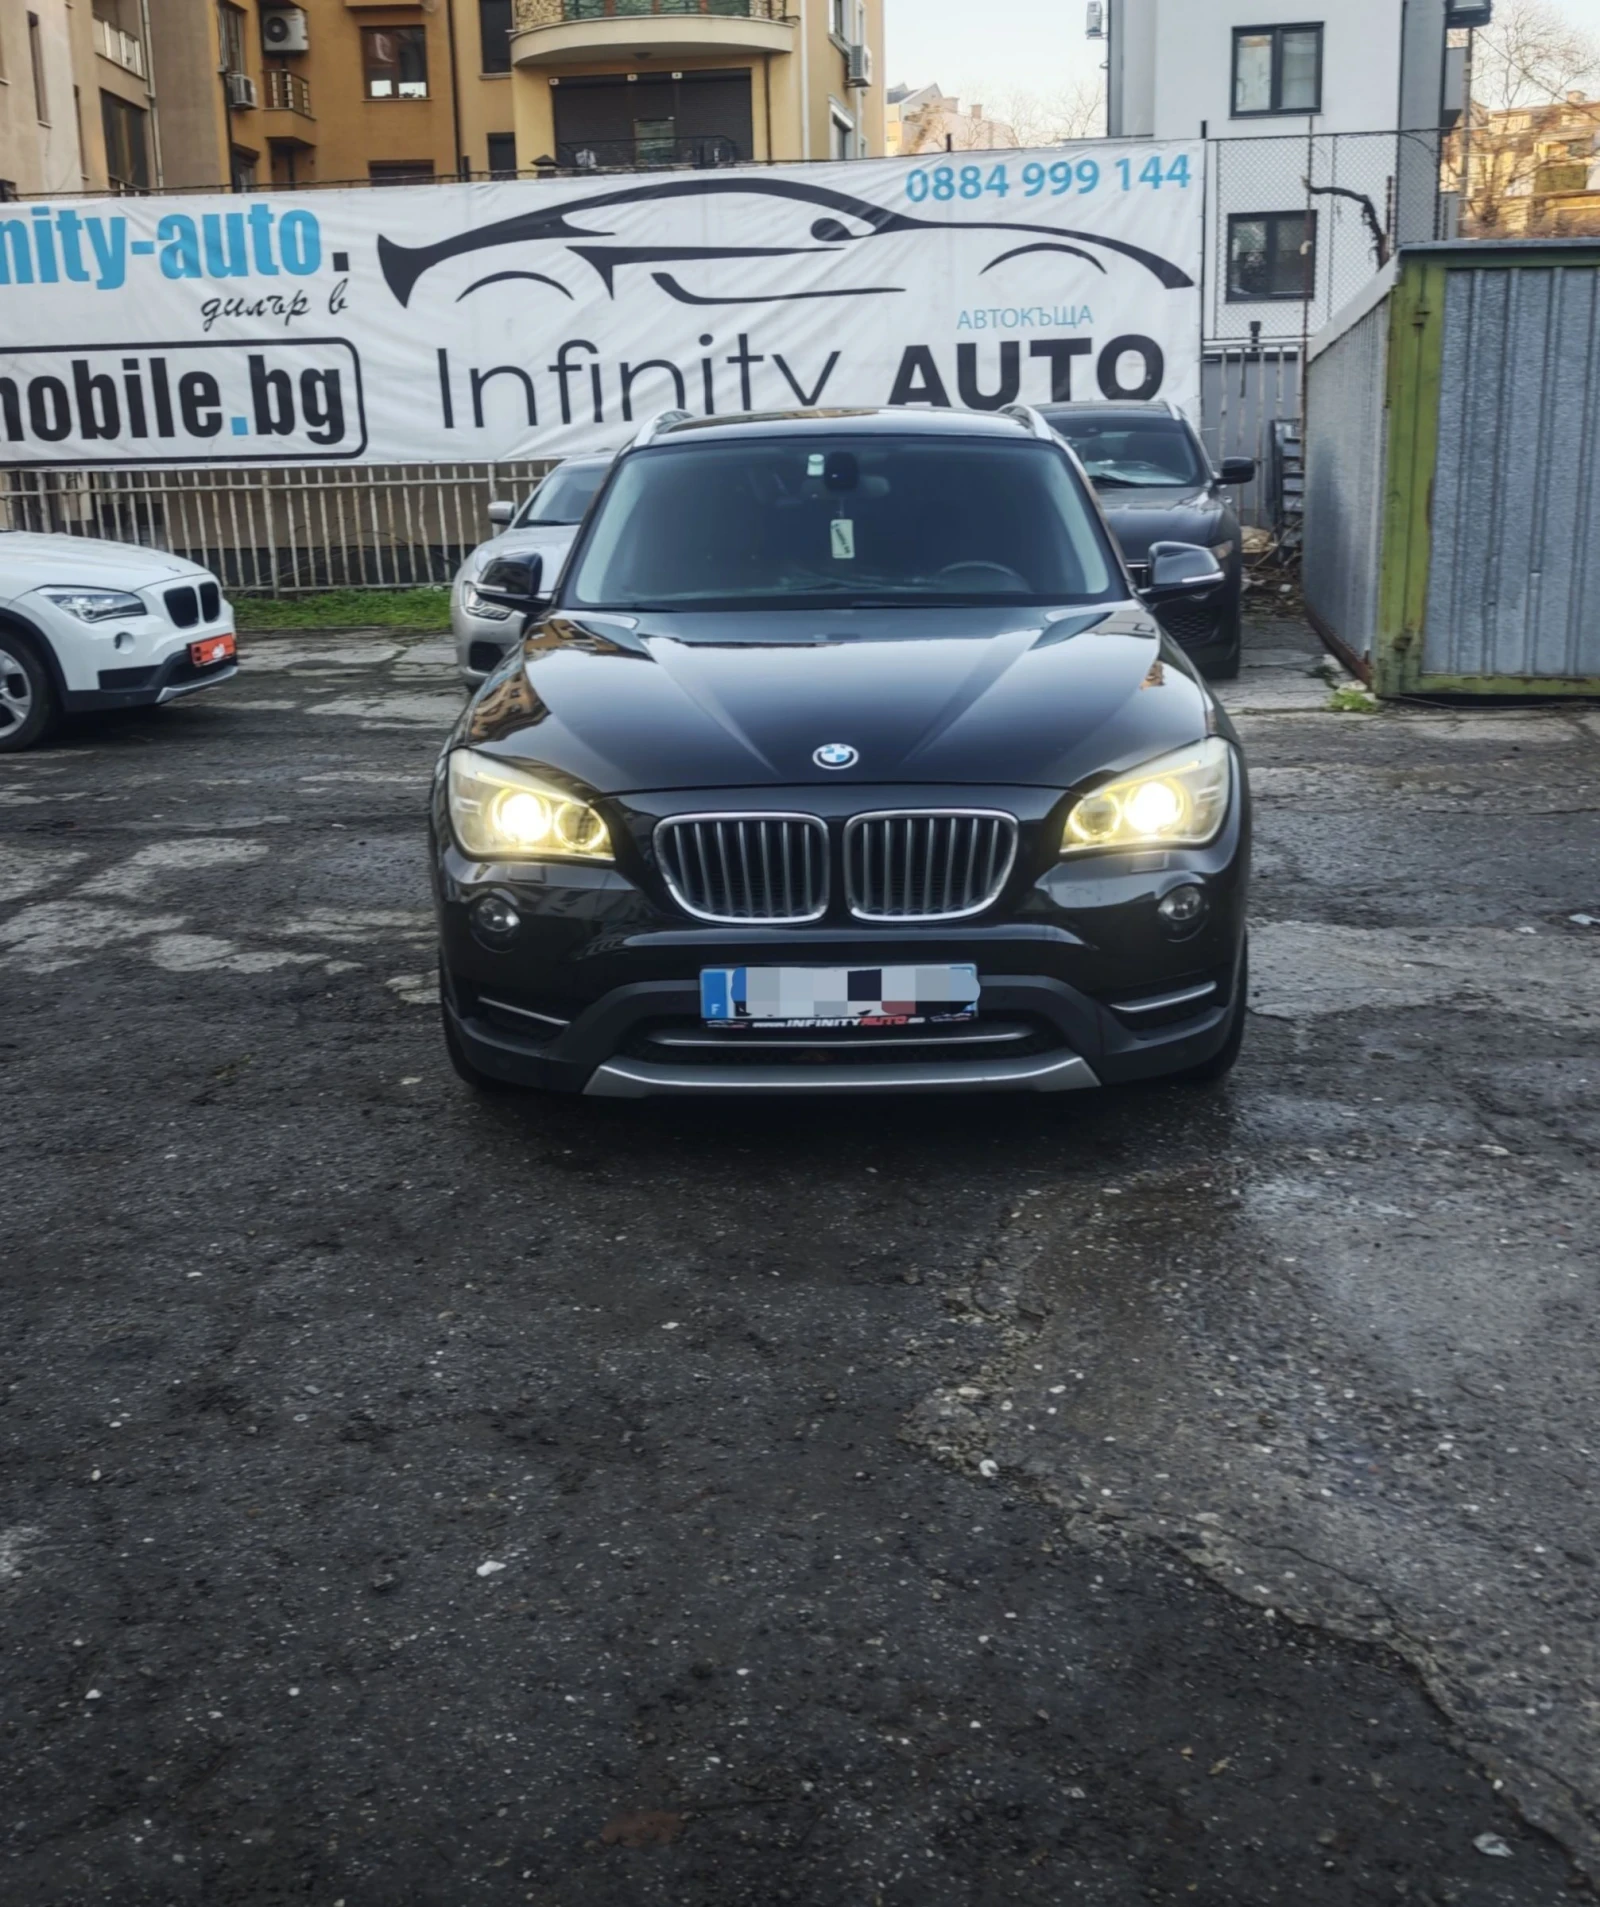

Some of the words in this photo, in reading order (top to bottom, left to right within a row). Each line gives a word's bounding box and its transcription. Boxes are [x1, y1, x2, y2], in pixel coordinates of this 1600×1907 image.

[905, 164, 1009, 202] 0884
[1021, 159, 1100, 197] 999
[1115, 154, 1192, 191] 144
[956, 304, 1095, 330] АВТОКЪЩА
[886, 334, 1165, 412] AUTO
